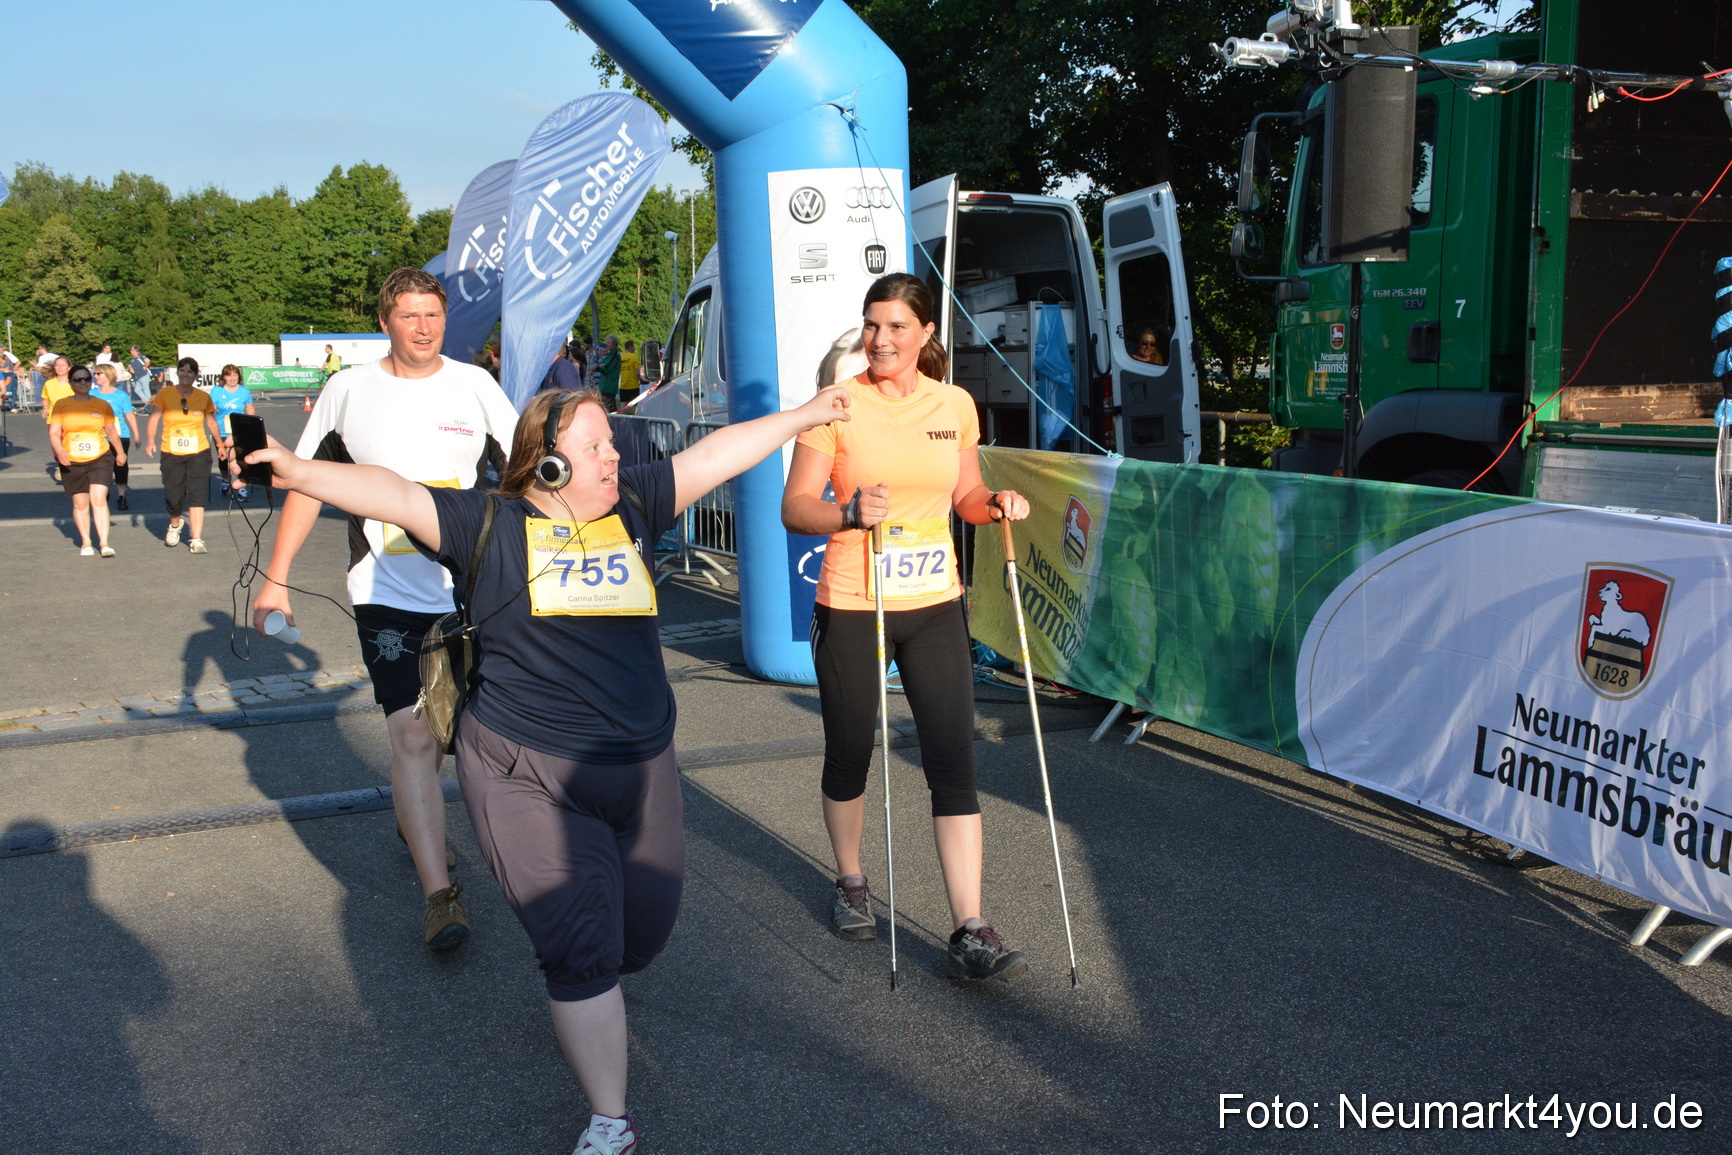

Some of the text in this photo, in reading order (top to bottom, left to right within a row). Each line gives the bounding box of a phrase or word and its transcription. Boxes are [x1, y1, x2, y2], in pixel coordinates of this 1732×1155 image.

[547, 122, 634, 257] Fischer
[580, 147, 645, 255] AUTOMOBILE
[846, 215, 871, 223] Audi
[867, 250, 885, 268] FIAT
[790, 274, 838, 284] SEAT
[1392, 287, 1427, 297] 26.340
[1405, 299, 1425, 309] EEV
[1455, 299, 1467, 318] 7
[78, 442, 91, 451] 59
[177, 438, 190, 448] 60
[552, 553, 629, 588] 755
[881, 549, 946, 579] 1572
[593, 594, 620, 603] Spitzer
[1593, 662, 1630, 688] 1628
[1512, 692, 1706, 791] Neumarkter
[1473, 724, 1732, 877] Lammsbräu
